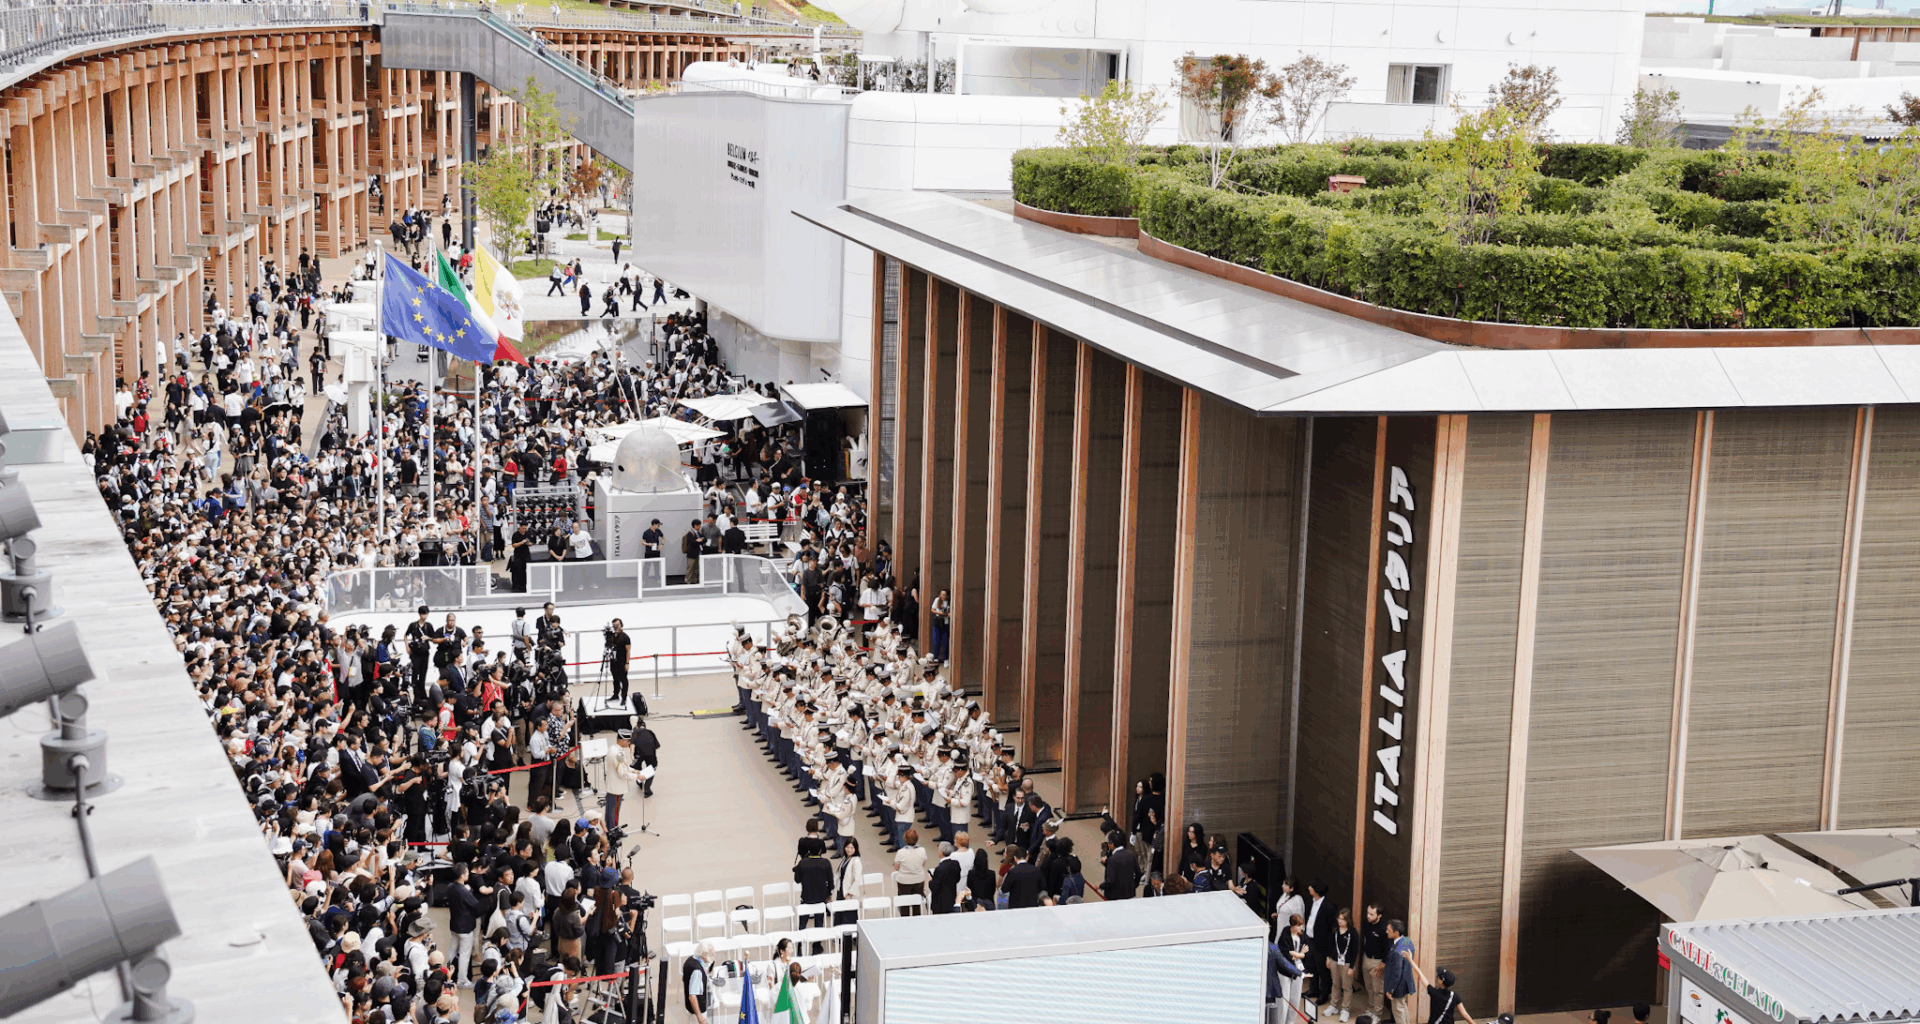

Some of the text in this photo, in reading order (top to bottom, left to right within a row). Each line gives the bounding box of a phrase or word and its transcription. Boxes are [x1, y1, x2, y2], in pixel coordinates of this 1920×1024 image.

[1373, 465, 1415, 835] ITALIA イタリア
